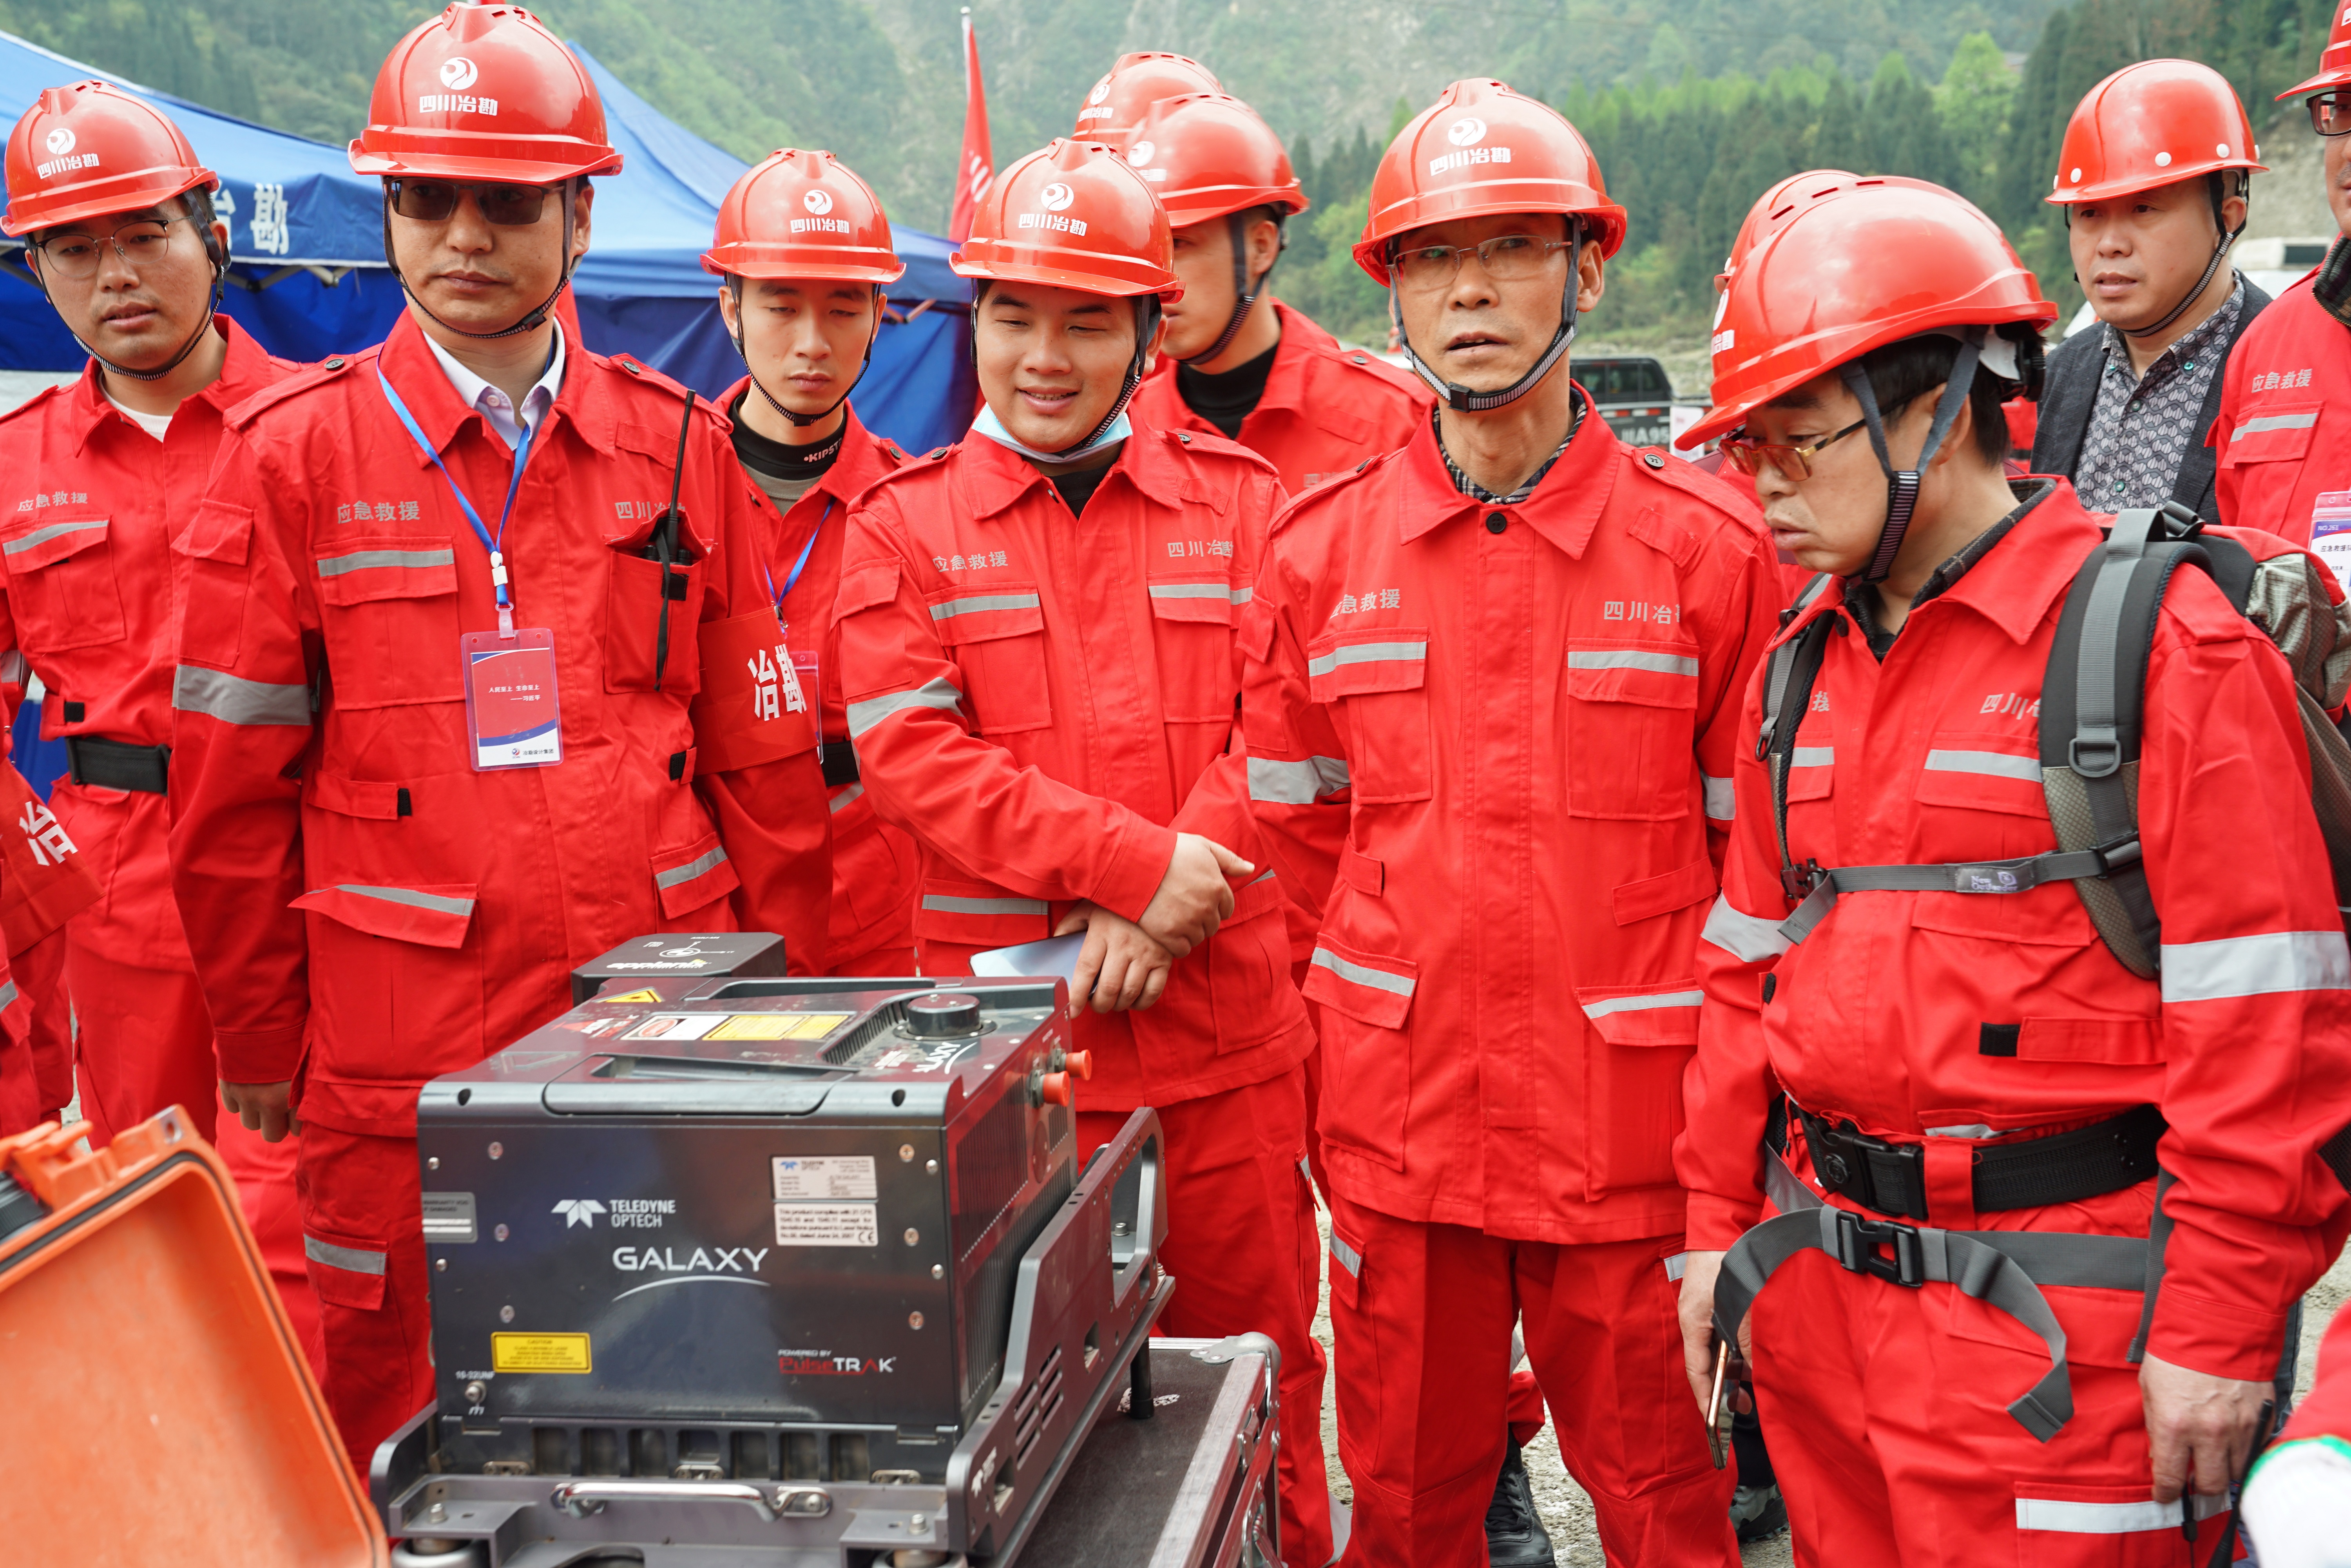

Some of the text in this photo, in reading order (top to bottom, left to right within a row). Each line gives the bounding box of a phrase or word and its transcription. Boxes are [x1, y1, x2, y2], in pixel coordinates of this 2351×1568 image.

[419, 94, 498, 116] 四川冶勘
[37, 153, 99, 179] 四川冶勘
[1429, 147, 1511, 176] 四川冶勘
[790, 218, 849, 234] 四川冶勘
[1019, 214, 1087, 237] 四川冶勘
[2252, 369, 2312, 393] 应急救援
[17, 491, 88, 512] 应急救援
[337, 500, 420, 525] 应急救援
[1168, 539, 1234, 558] 四川冶勘
[932, 550, 1009, 572] 应急救援
[1604, 601, 1680, 624] 四川冶
[748, 643, 807, 721] 冶勘
[609, 1200, 676, 1213] TELEDYNE
[611, 1214, 662, 1228] OPTECH
[612, 1246, 769, 1272] GALAXY
